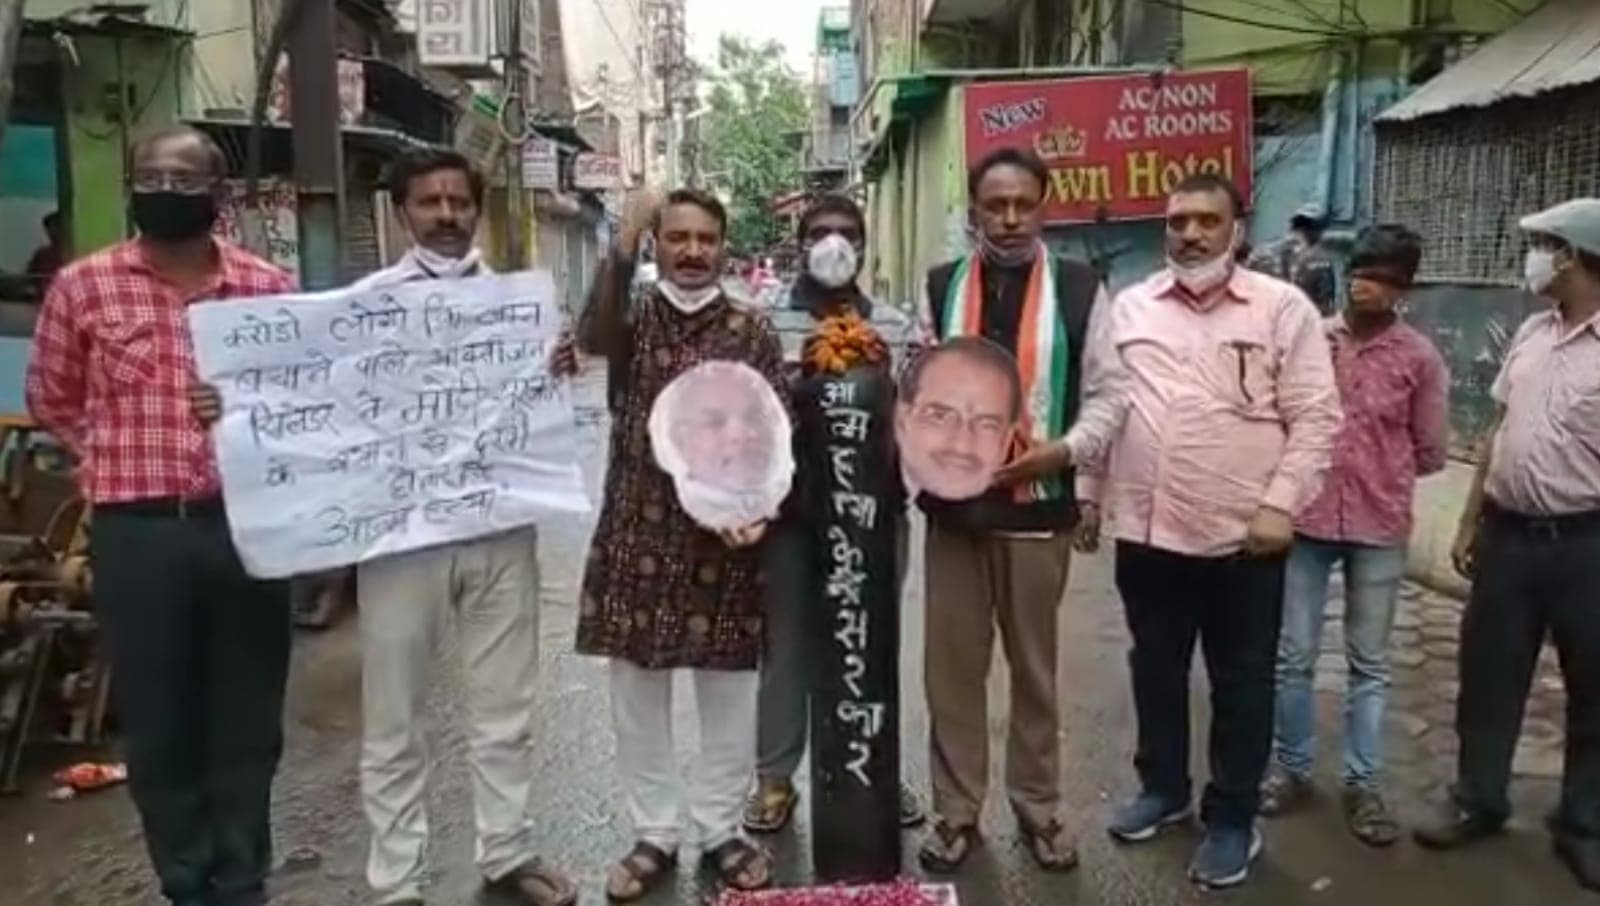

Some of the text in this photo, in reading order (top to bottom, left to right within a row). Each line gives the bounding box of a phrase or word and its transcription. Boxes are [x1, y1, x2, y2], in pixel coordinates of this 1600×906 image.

[1119, 84, 1216, 111] AC/NON
[980, 97, 1046, 136] New
[1105, 110, 1232, 140] AC ROOMS
